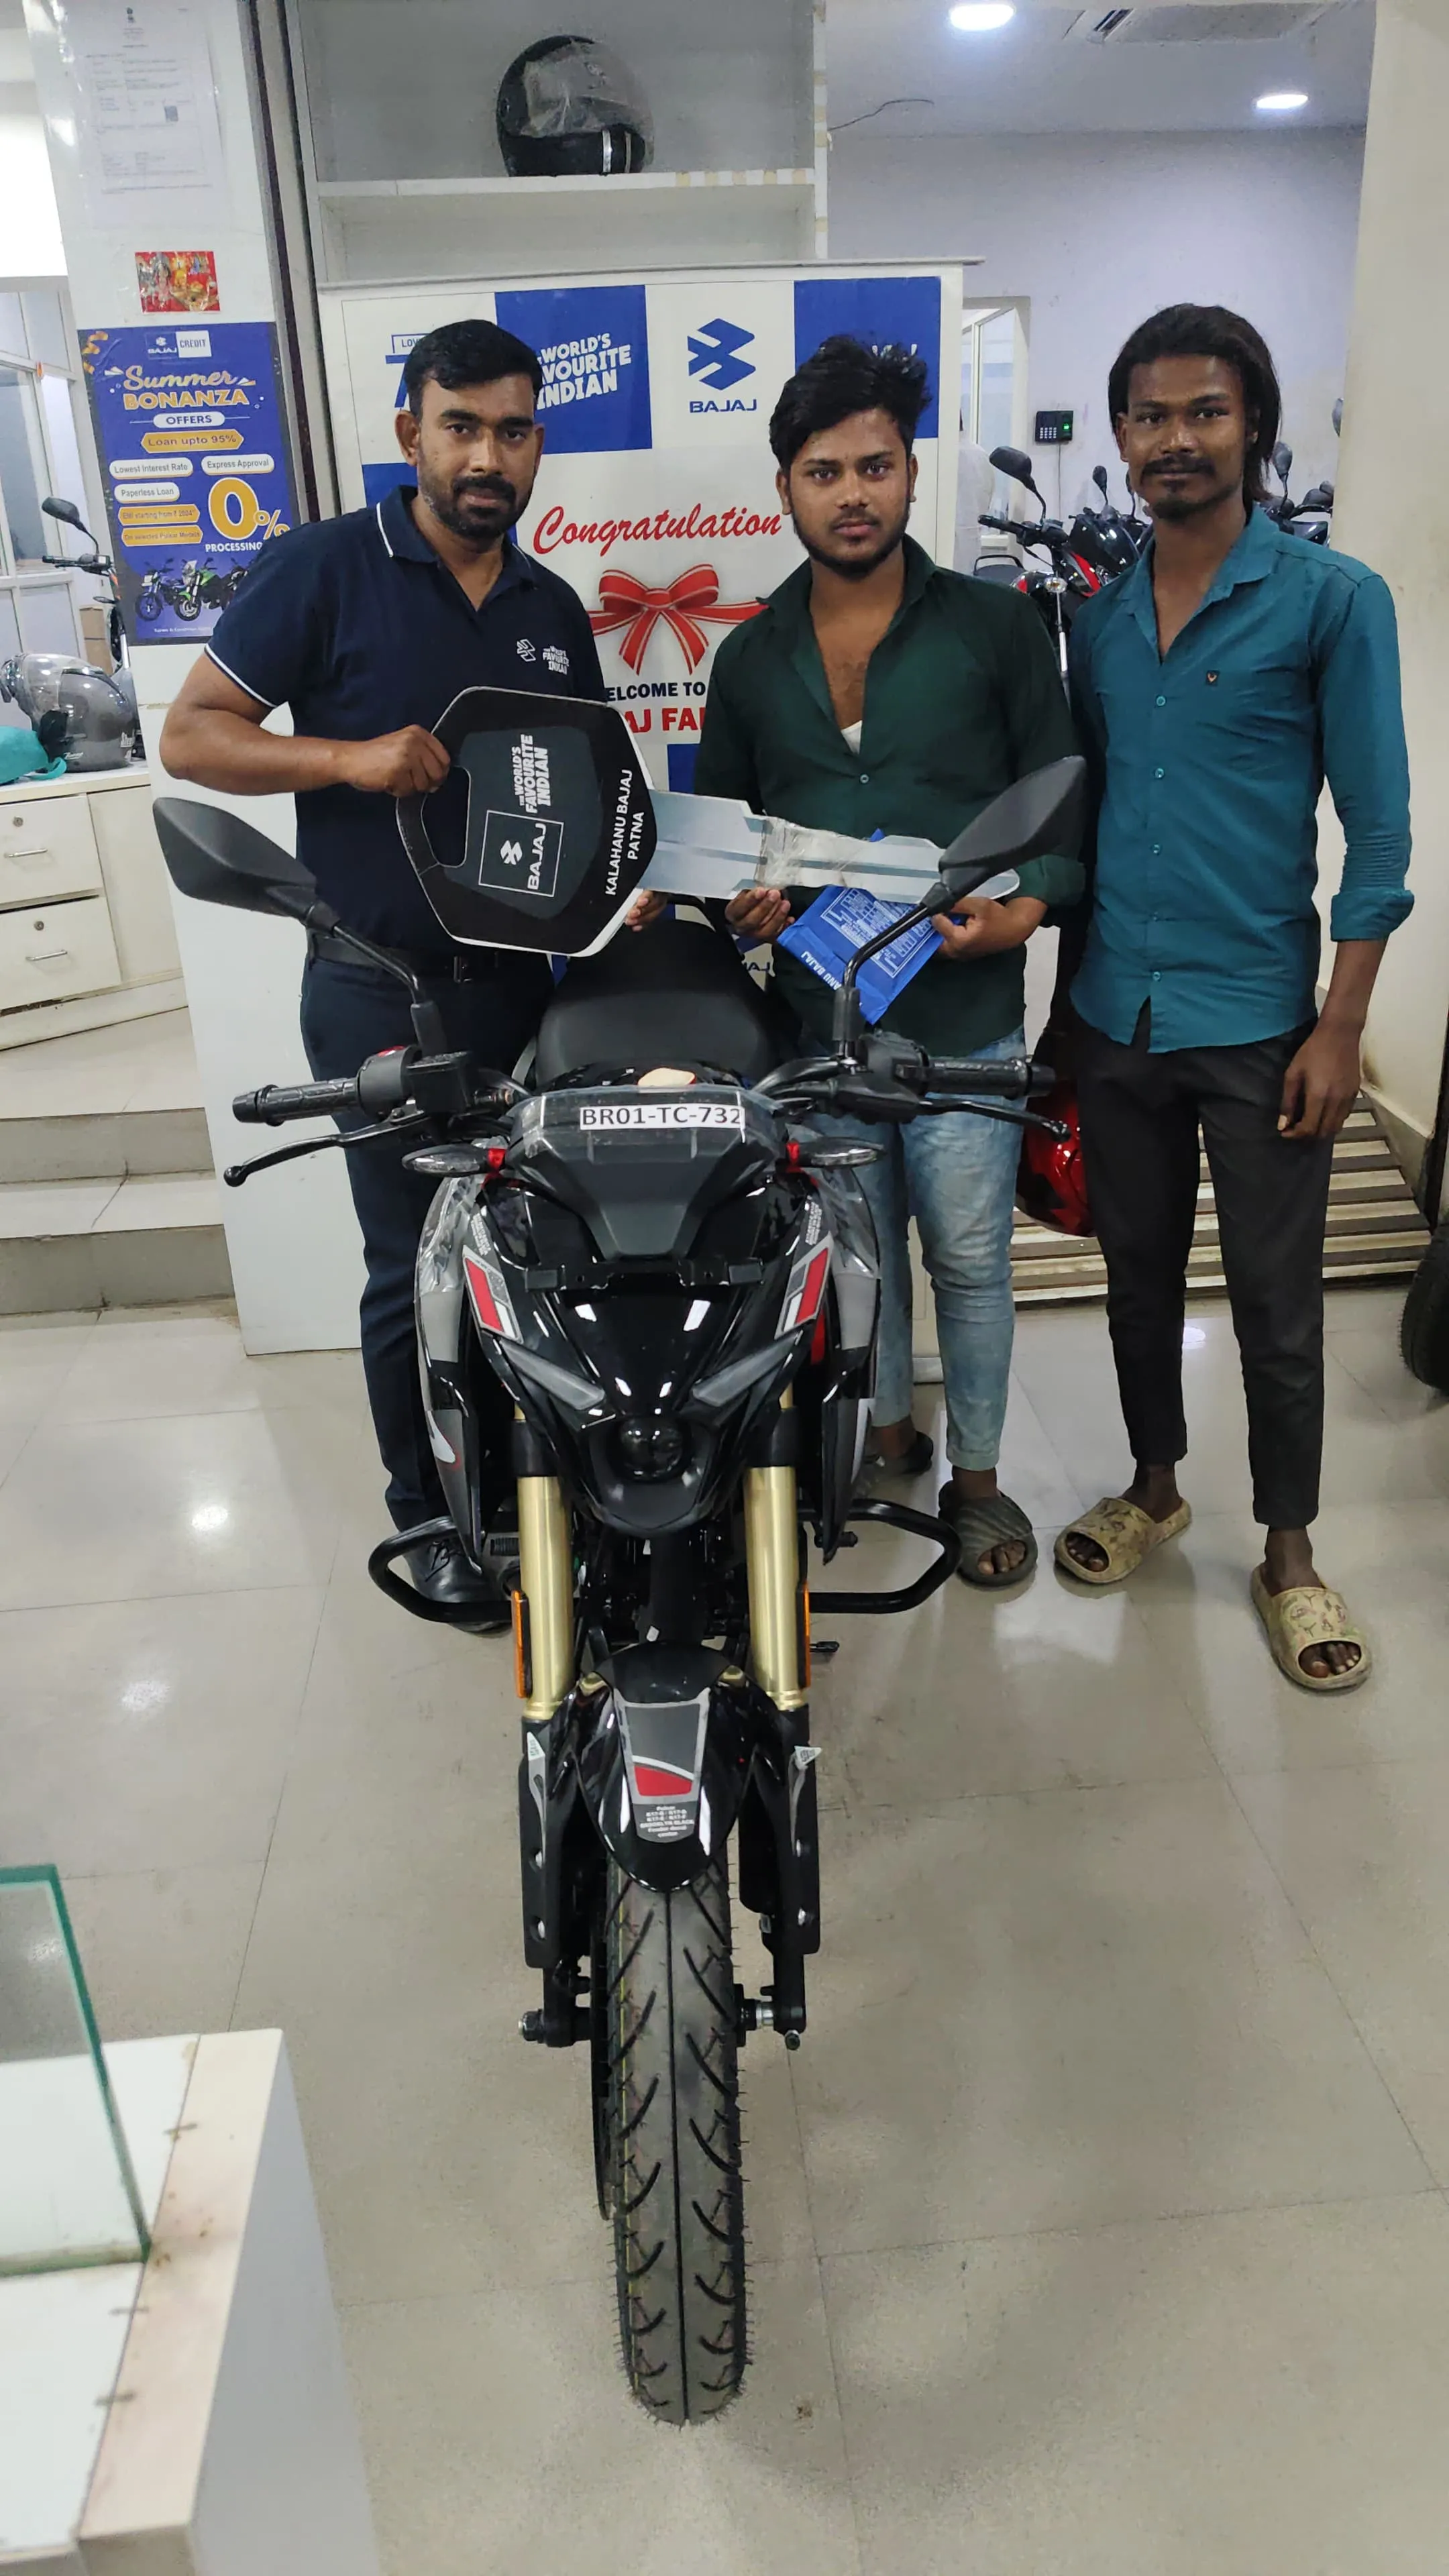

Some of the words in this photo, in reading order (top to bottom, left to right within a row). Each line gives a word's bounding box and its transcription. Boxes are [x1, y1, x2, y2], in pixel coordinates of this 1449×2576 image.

[179, 338, 206, 349] CREDIT
[541, 333, 611, 363] WORLD'S
[123, 364, 238, 390] Summer
[541, 344, 632, 385] VOURITE
[123, 388, 250, 411] BONANZA
[537, 368, 618, 411] INDIAN
[689, 398, 757, 414] BAJAJ
[166, 415, 213, 425] OFFERS
[148, 438, 178, 447] Loan
[181, 437, 208, 446] upto
[211, 435, 237, 444] 95%
[114, 464, 142, 474] Lowest
[171, 462, 189, 471] Rate
[207, 460, 235, 470] Express
[237, 458, 270, 469] Approval
[121, 488, 156, 498] Paperless
[157, 487, 174, 496] Loan
[533, 502, 782, 557] Congratulation
[606, 682, 678, 702] ELCOME
[683, 682, 706, 696] TO
[511, 746, 524, 796] WORLD'S
[520, 734, 538, 814] FAVOURITE
[533, 747, 551, 806] INDIAN
[605, 816, 627, 896] KALAHANU
[616, 769, 633, 814] BAJAJ
[627, 812, 645, 860] PATNA
[527, 822, 547, 890] BAJAJ
[582, 1107, 741, 1126] BR01-TC-732
